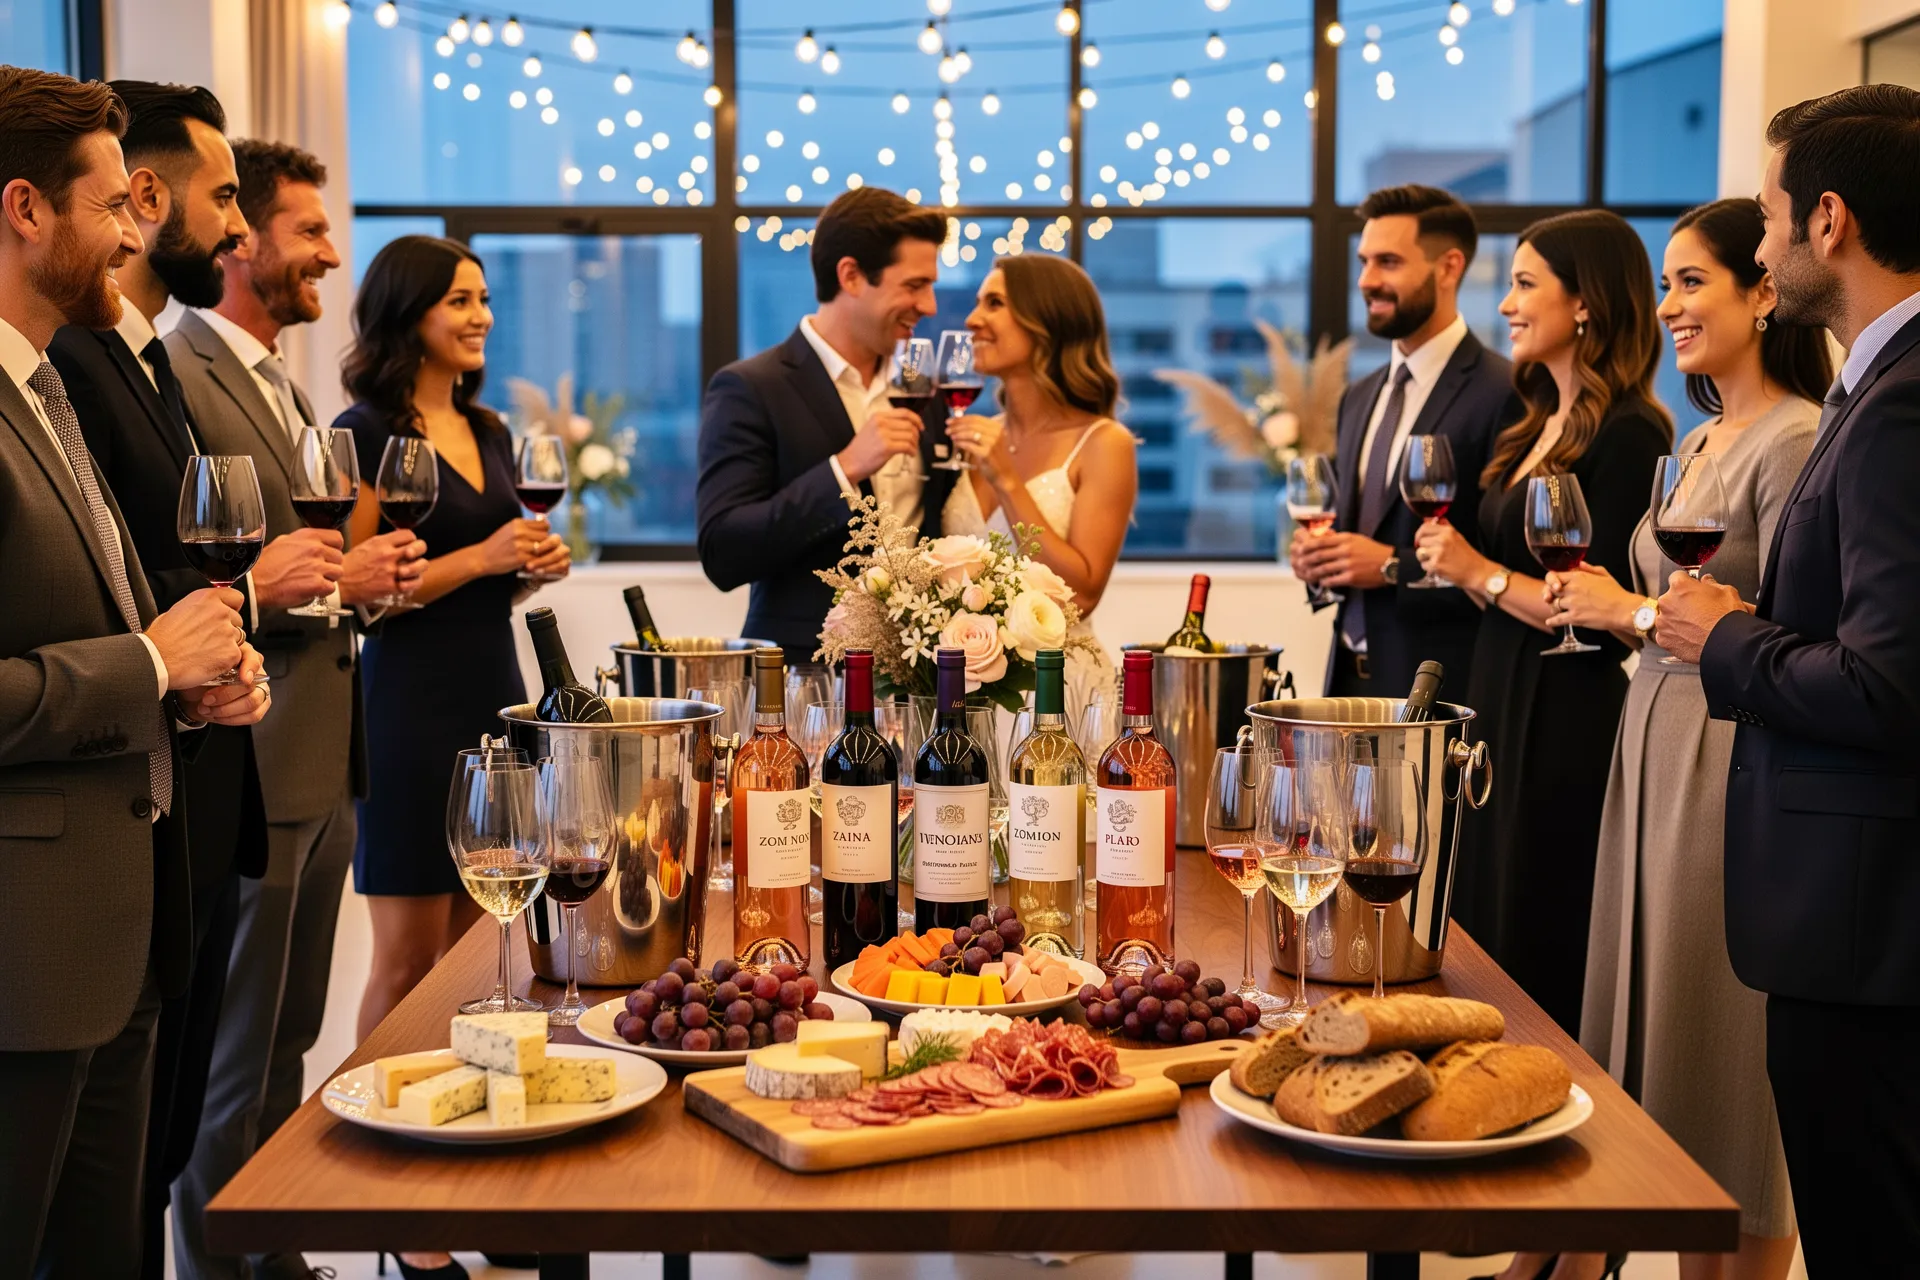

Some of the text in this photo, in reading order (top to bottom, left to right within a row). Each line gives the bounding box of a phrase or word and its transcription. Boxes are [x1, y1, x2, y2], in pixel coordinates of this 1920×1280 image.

[833, 830, 871, 842] ZAINA
[1014, 828, 1061, 841] ZOMION
[759, 836, 787, 846] ZOM
